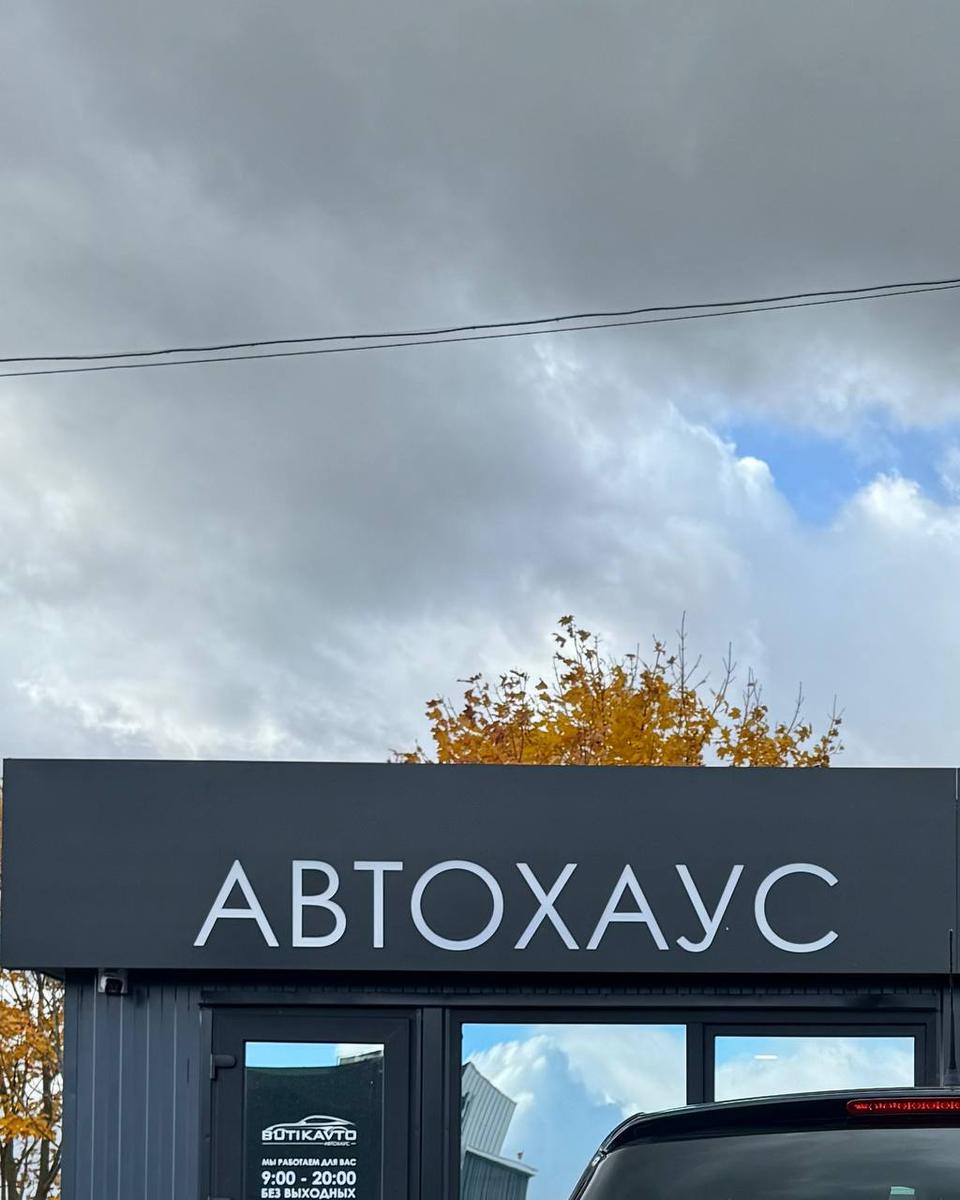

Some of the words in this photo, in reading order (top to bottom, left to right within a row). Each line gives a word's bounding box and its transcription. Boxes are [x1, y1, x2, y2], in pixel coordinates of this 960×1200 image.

[193, 858, 839, 954] АВТОХАУС
[262, 1129, 357, 1141] BUTIKAVTO
[261, 1158, 277, 1167] МЫ
[277, 1158, 320, 1167] РАБОТАЕМ
[320, 1158, 338, 1168] ДЛЯ
[339, 1158, 357, 1167] ВАС
[261, 1170, 296, 1186] 9:00
[311, 1170, 357, 1186] 20:00
[260, 1187, 282, 1199] БЕЗ
[283, 1187, 357, 1200] ВЫХОДНЫХ
